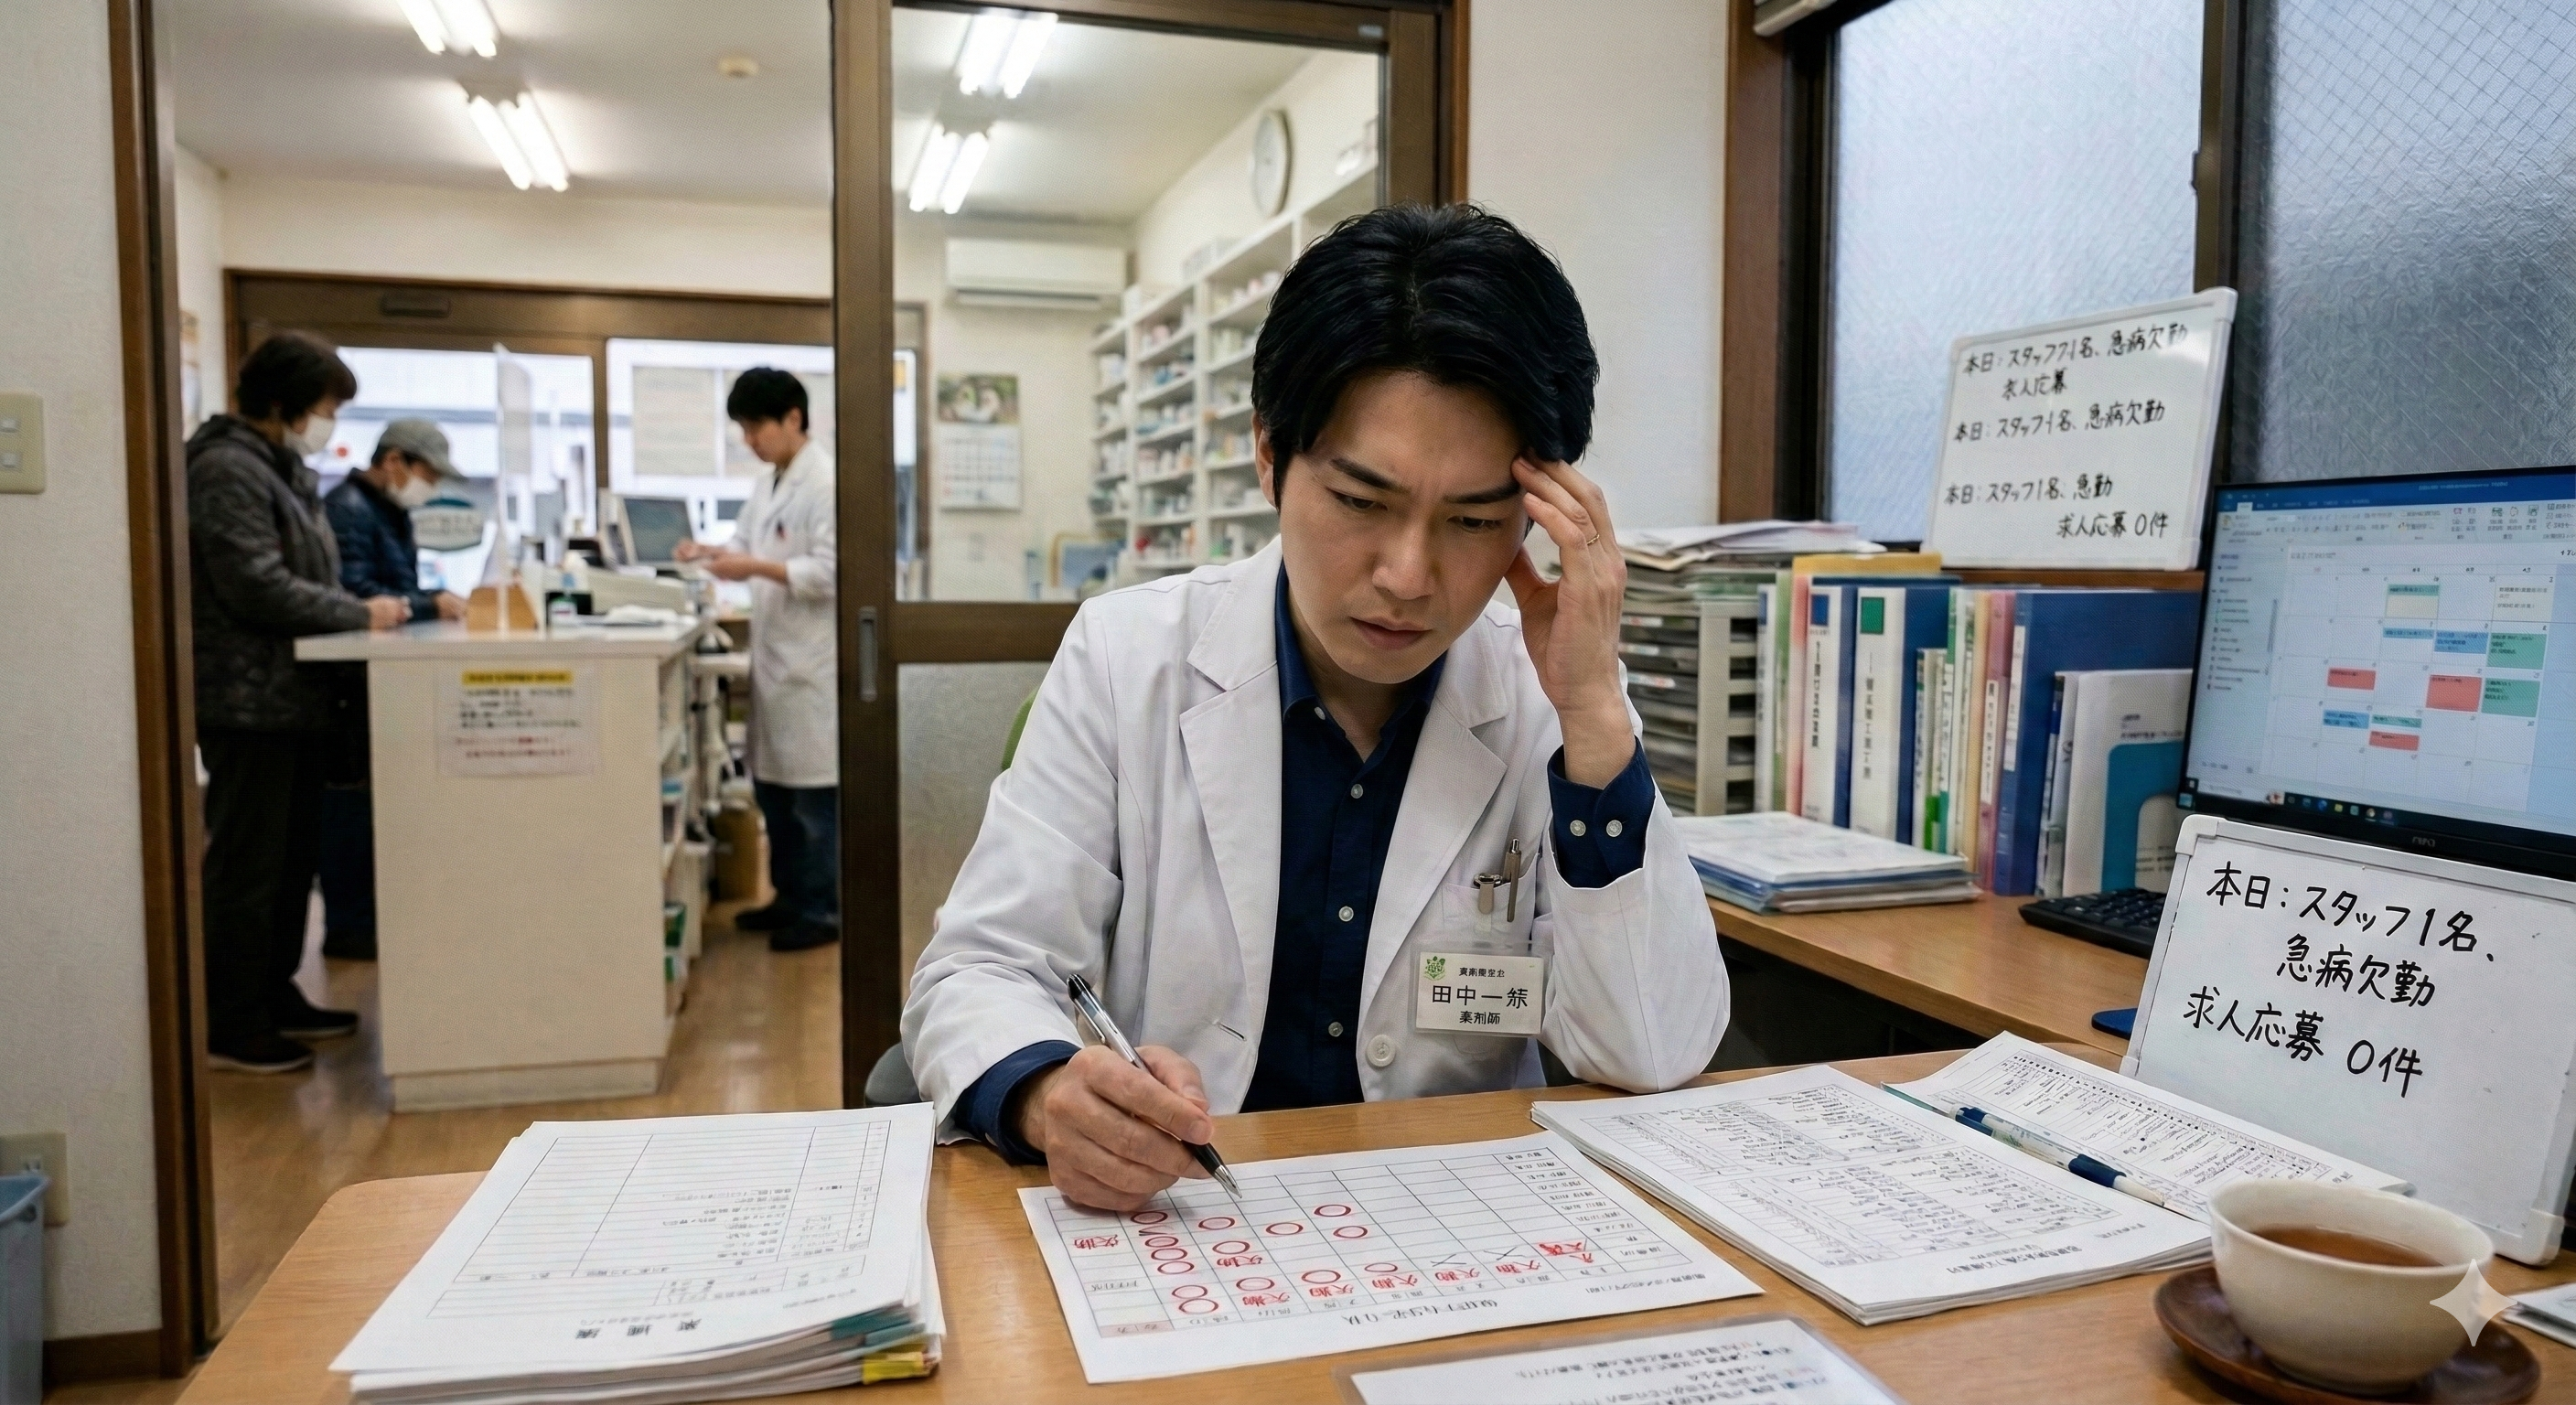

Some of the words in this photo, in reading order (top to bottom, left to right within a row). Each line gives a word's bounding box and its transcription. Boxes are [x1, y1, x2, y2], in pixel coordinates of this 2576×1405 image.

[2057, 510, 2127, 538] 求人応募
[2276, 933, 2435, 1008] 急病欠勤
[1459, 1011, 1501, 1024] 薬剤師
[2183, 985, 2324, 1062] 求人応募
[2346, 1039, 2423, 1099] 0件
